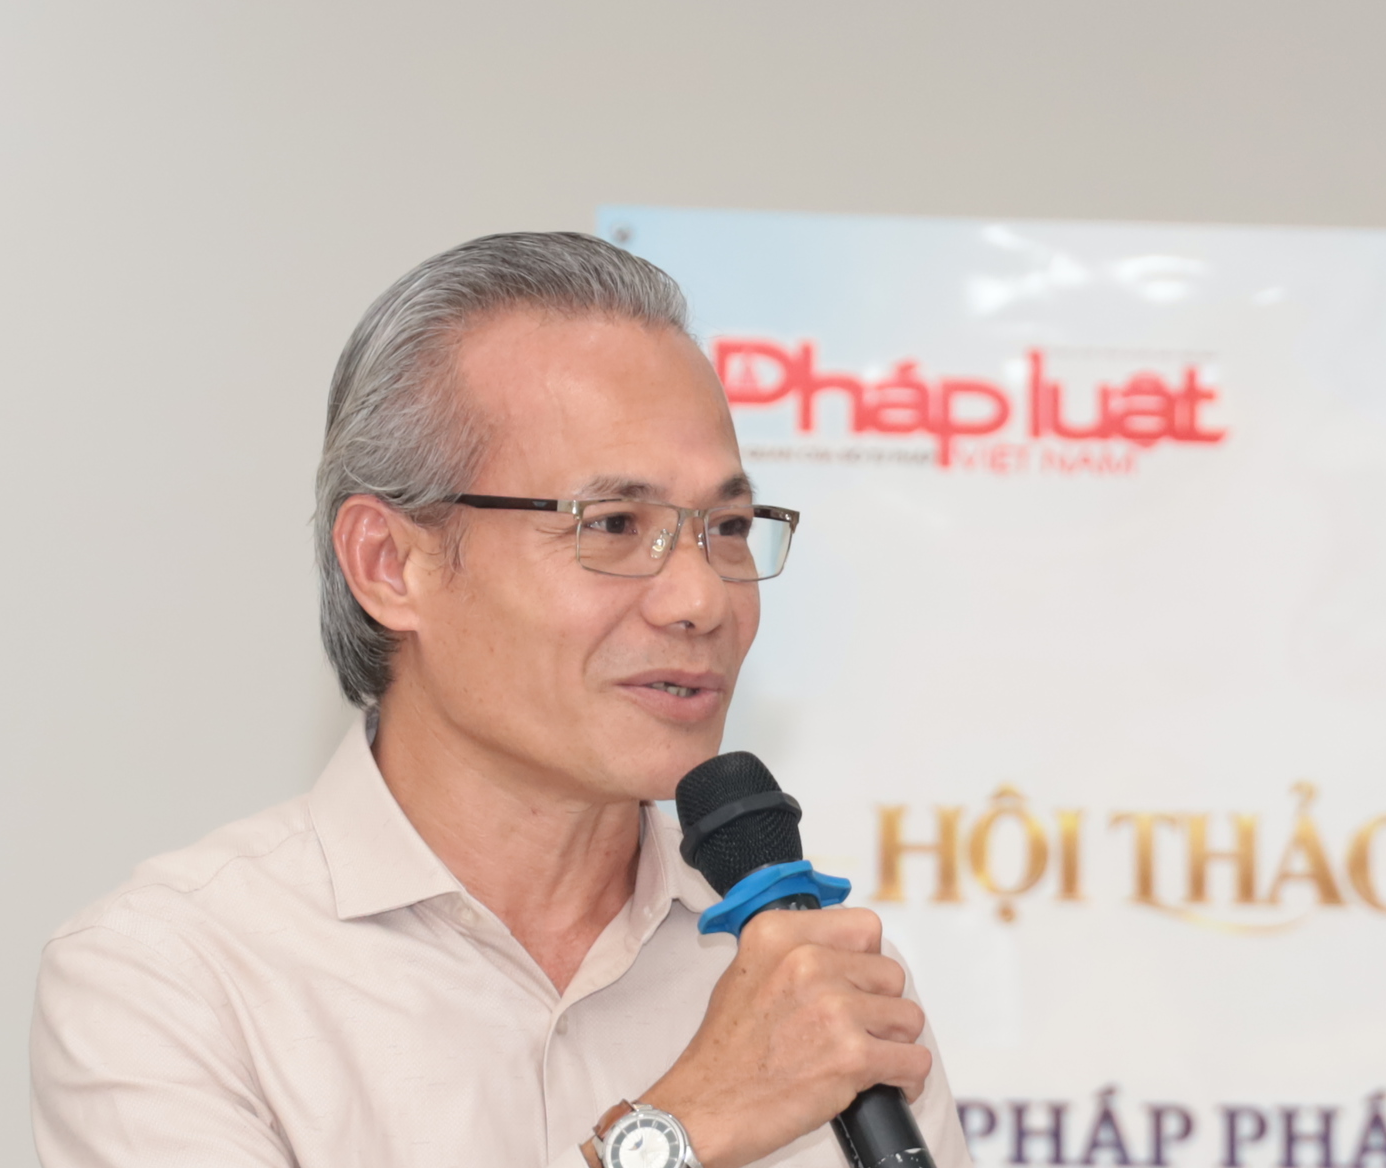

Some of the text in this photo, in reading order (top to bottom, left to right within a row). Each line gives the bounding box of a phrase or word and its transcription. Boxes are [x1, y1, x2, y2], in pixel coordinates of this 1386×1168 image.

[714, 337, 1225, 469] Pháp luật
[870, 783, 1085, 925] HỘI
[957, 1083, 1195, 1168] PHÁP
